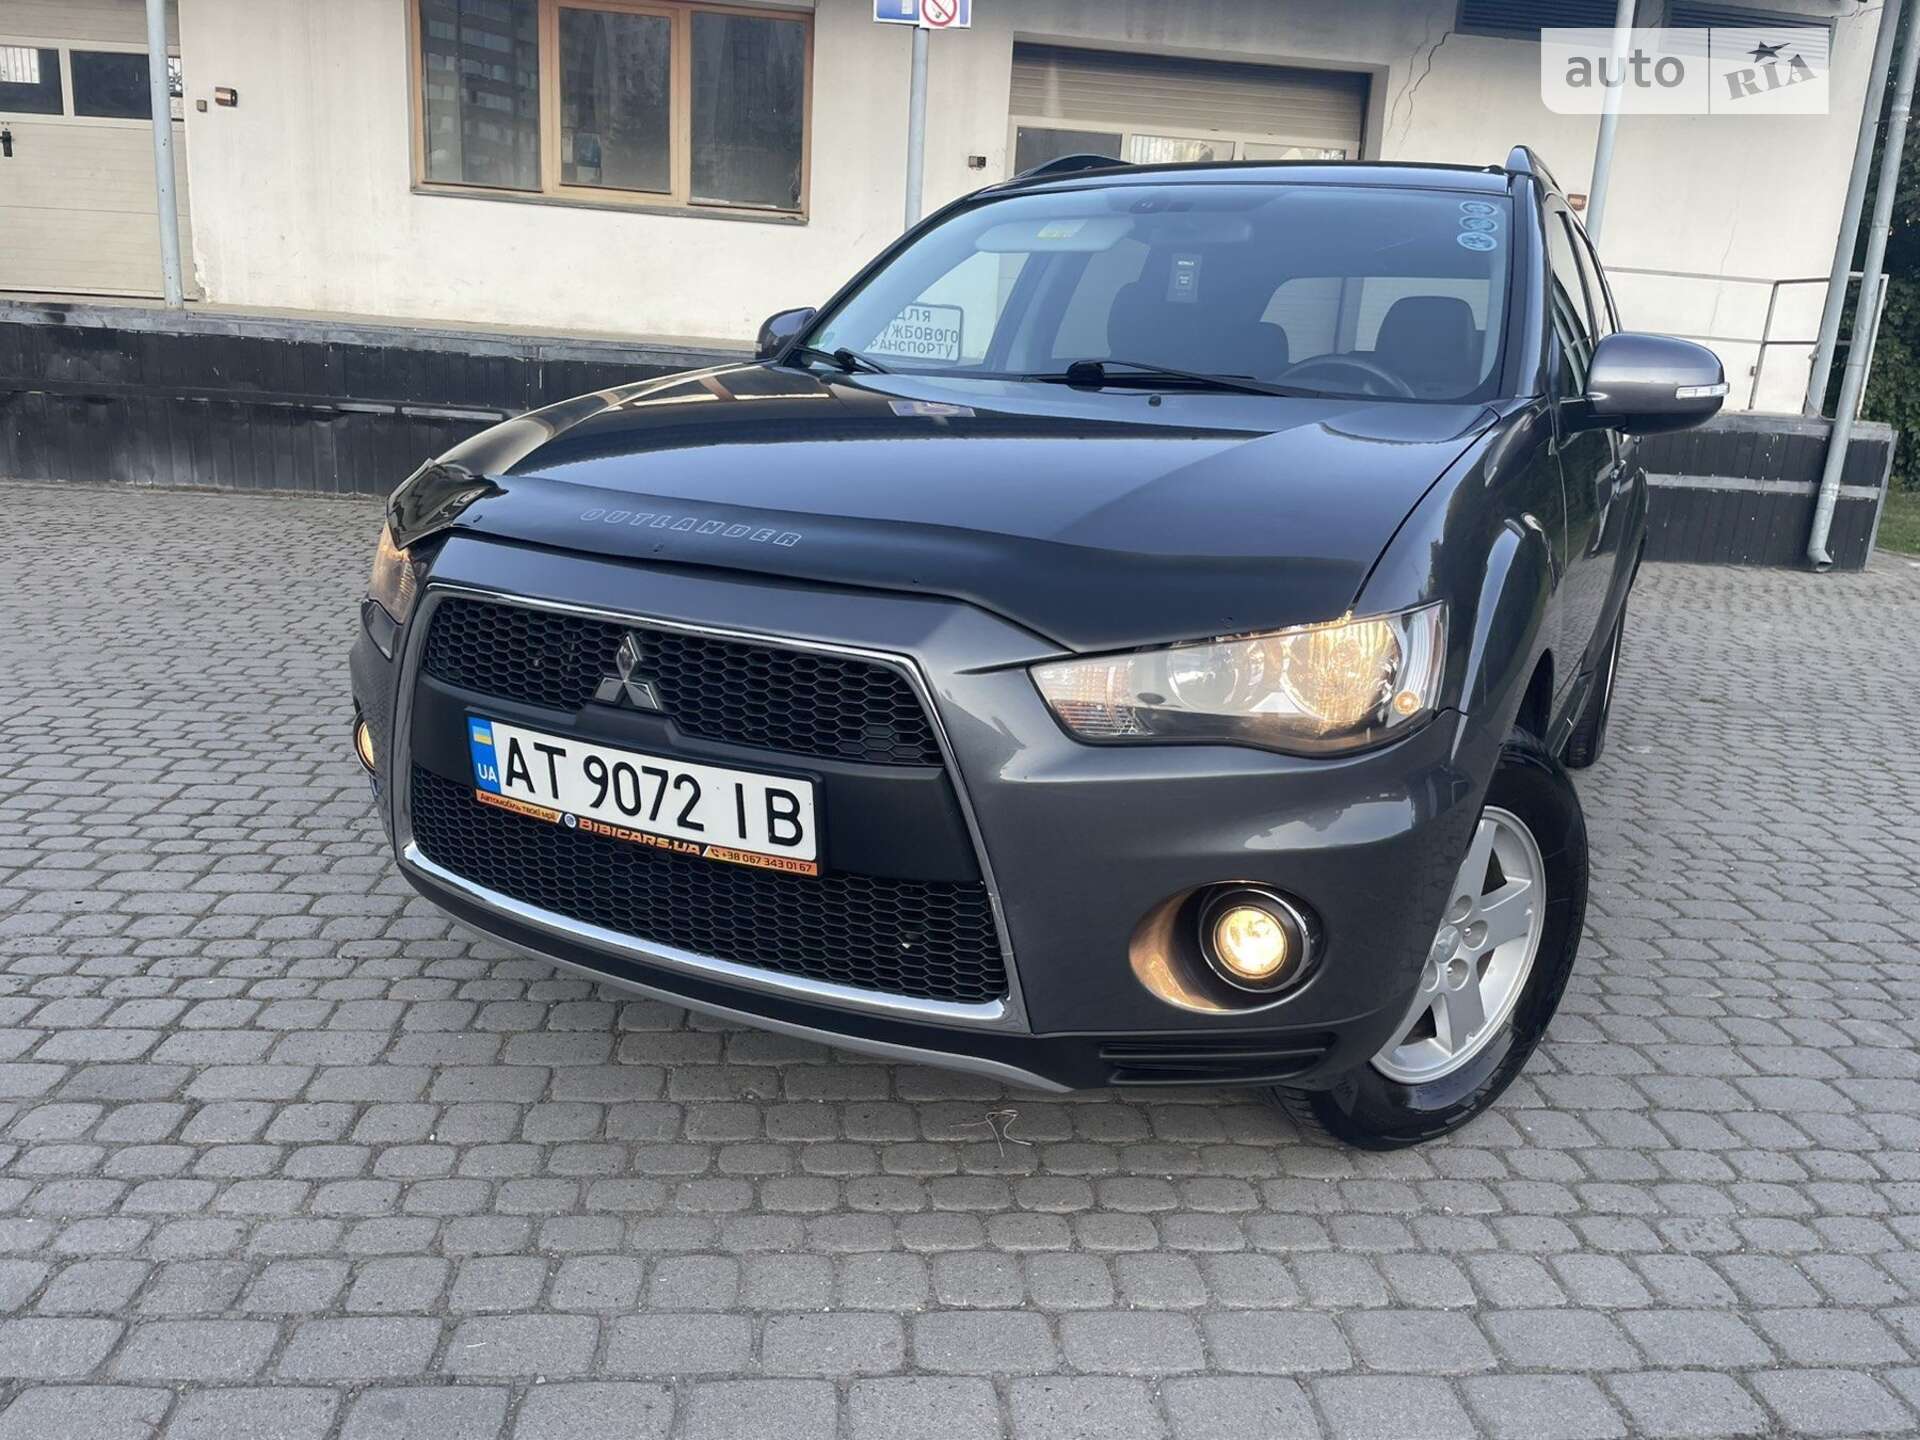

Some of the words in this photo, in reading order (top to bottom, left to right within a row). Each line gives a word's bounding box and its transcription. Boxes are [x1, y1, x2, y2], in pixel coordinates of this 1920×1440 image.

[870, 339, 953, 358] РАНСПОРТУ
[580, 508, 802, 547] OUTLANDER
[478, 763, 497, 782] UA
[505, 737, 566, 800] AT
[583, 754, 704, 832] 9072
[735, 783, 804, 847] IB
[579, 818, 700, 855] BIBICARS.UA
[722, 851, 741, 861] +38
[742, 854, 761, 865] 067
[764, 857, 784, 868] 343
[786, 862, 797, 870] 01
[799, 864, 812, 872] 67
